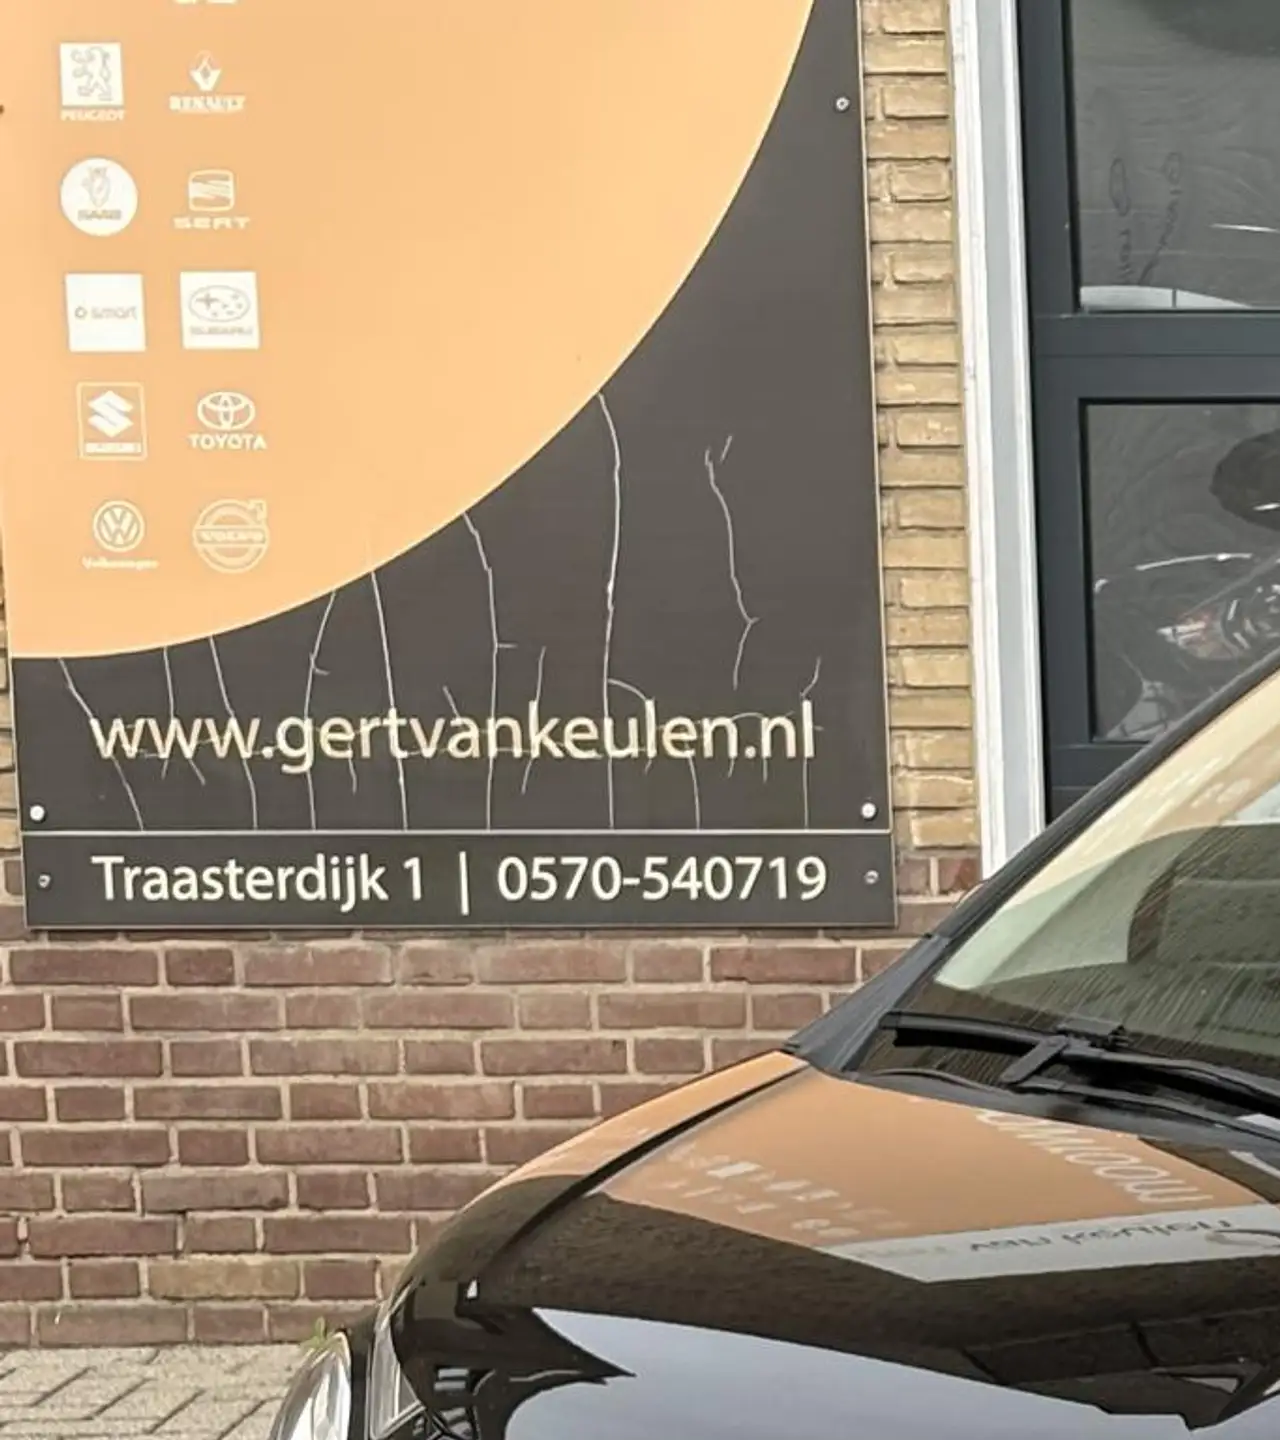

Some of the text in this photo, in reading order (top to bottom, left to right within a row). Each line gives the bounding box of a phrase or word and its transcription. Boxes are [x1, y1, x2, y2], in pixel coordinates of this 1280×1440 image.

[173, 216, 251, 229] SEAT
[188, 433, 267, 450] TOYOTA
[90, 700, 815, 773] www.gertvankeulen.nl
[91, 852, 389, 913] Traasterdijk
[403, 857, 423, 900] 1
[498, 856, 827, 900] 0570-540719
